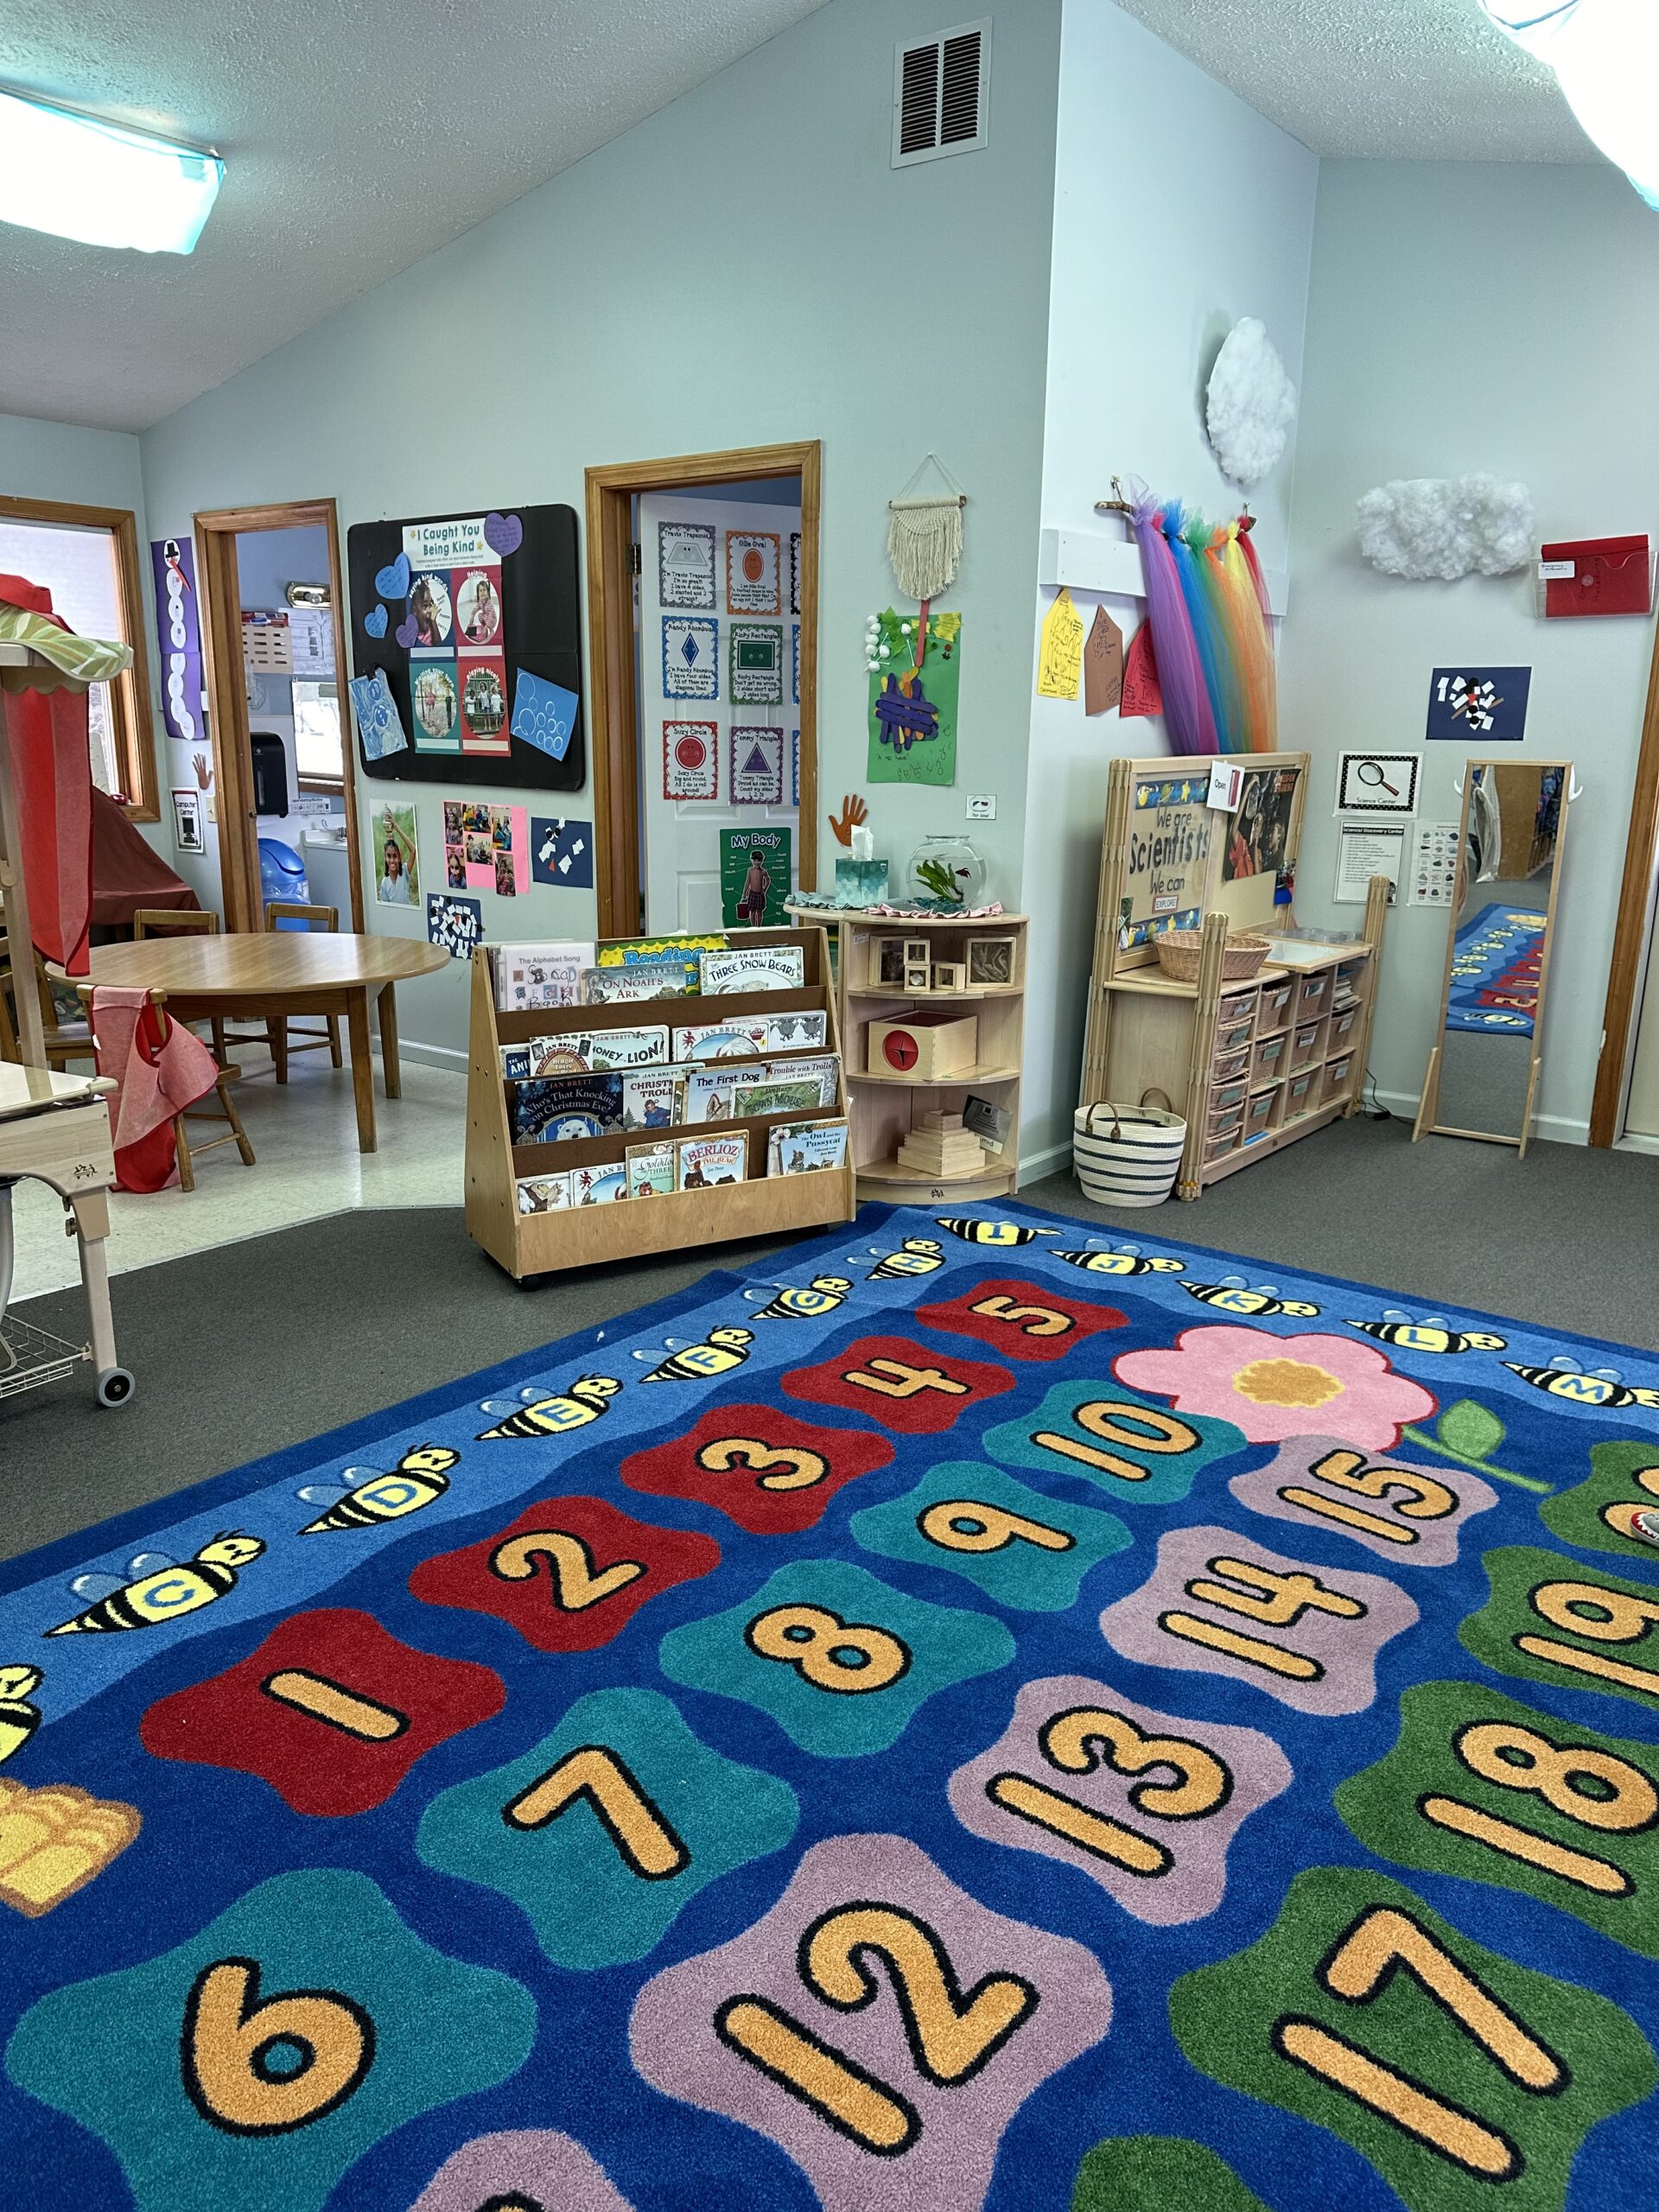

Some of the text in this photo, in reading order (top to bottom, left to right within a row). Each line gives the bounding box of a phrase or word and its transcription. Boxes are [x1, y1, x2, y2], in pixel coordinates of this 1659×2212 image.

[417, 524, 480, 540] I Caught You
[423, 541, 474, 556] Being Kind
[422, 572, 433, 581] kind
[434, 575, 448, 591] words
[467, 569, 487, 578] Helping
[467, 666, 500, 683] playing nicely
[1215, 779, 1226, 790] Open
[1157, 805, 1192, 829] We are
[731, 833, 780, 849] My Body
[1129, 823, 1210, 874] Scientists
[1150, 870, 1185, 894] We can
[1155, 896, 1177, 909] EXPLORE
[623, 947, 705, 966] Reading
[709, 963, 739, 982] THREE
[741, 959, 766, 970] SNOW
[768, 959, 796, 976] BEARS
[603, 978, 664, 989] ON NOAH'S
[617, 989, 639, 999] ARK
[700, 1027, 747, 1039] JAN BRETT
[627, 1039, 664, 1063] LION!
[770, 1065, 796, 1074] Trouble
[811, 1062, 831, 1071] Trolls
[696, 1073, 760, 1087] The First Dog
[524, 1089, 617, 1115] Who's That Knocking
[531, 1112, 544, 1122] on
[543, 1100, 590, 1114] Christmas
[746, 1093, 806, 1114] TOWN MOUSE
[687, 1144, 739, 1162] BERLIOZ
[805, 1138, 841, 1147] Pussycat
[598, 1166, 614, 1179] JAN
[893, 1255, 931, 1271] H
[1096, 1257, 1128, 1269] J
[790, 1289, 831, 1311] G
[1220, 1293, 1257, 1308] K
[967, 1293, 1074, 1336] 5
[1402, 1328, 1443, 1346] L
[687, 1351, 721, 1369] F
[841, 1357, 972, 1399] 4
[1554, 1378, 1606, 1402] M
[533, 1402, 584, 1424] E
[1029, 1398, 1205, 1483] 10
[695, 1435, 831, 1492] 3
[363, 1484, 418, 1509] D
[1277, 1448, 1460, 1546] 15
[916, 1498, 1078, 1555] 9
[488, 1528, 648, 1613] 2
[143, 1580, 195, 1608] C
[1158, 1554, 1369, 1684] 14
[744, 1601, 913, 1695] 8
[1512, 1579, 1659, 1698] 19
[260, 1668, 410, 1743] 1
[985, 1705, 1234, 1879] 13
[500, 1743, 692, 1882] 7
[1415, 1719, 1659, 1898] 18
[713, 1899, 1040, 2158] 12
[179, 1955, 377, 2139] 6
[1270, 1902, 1574, 2184] 17
